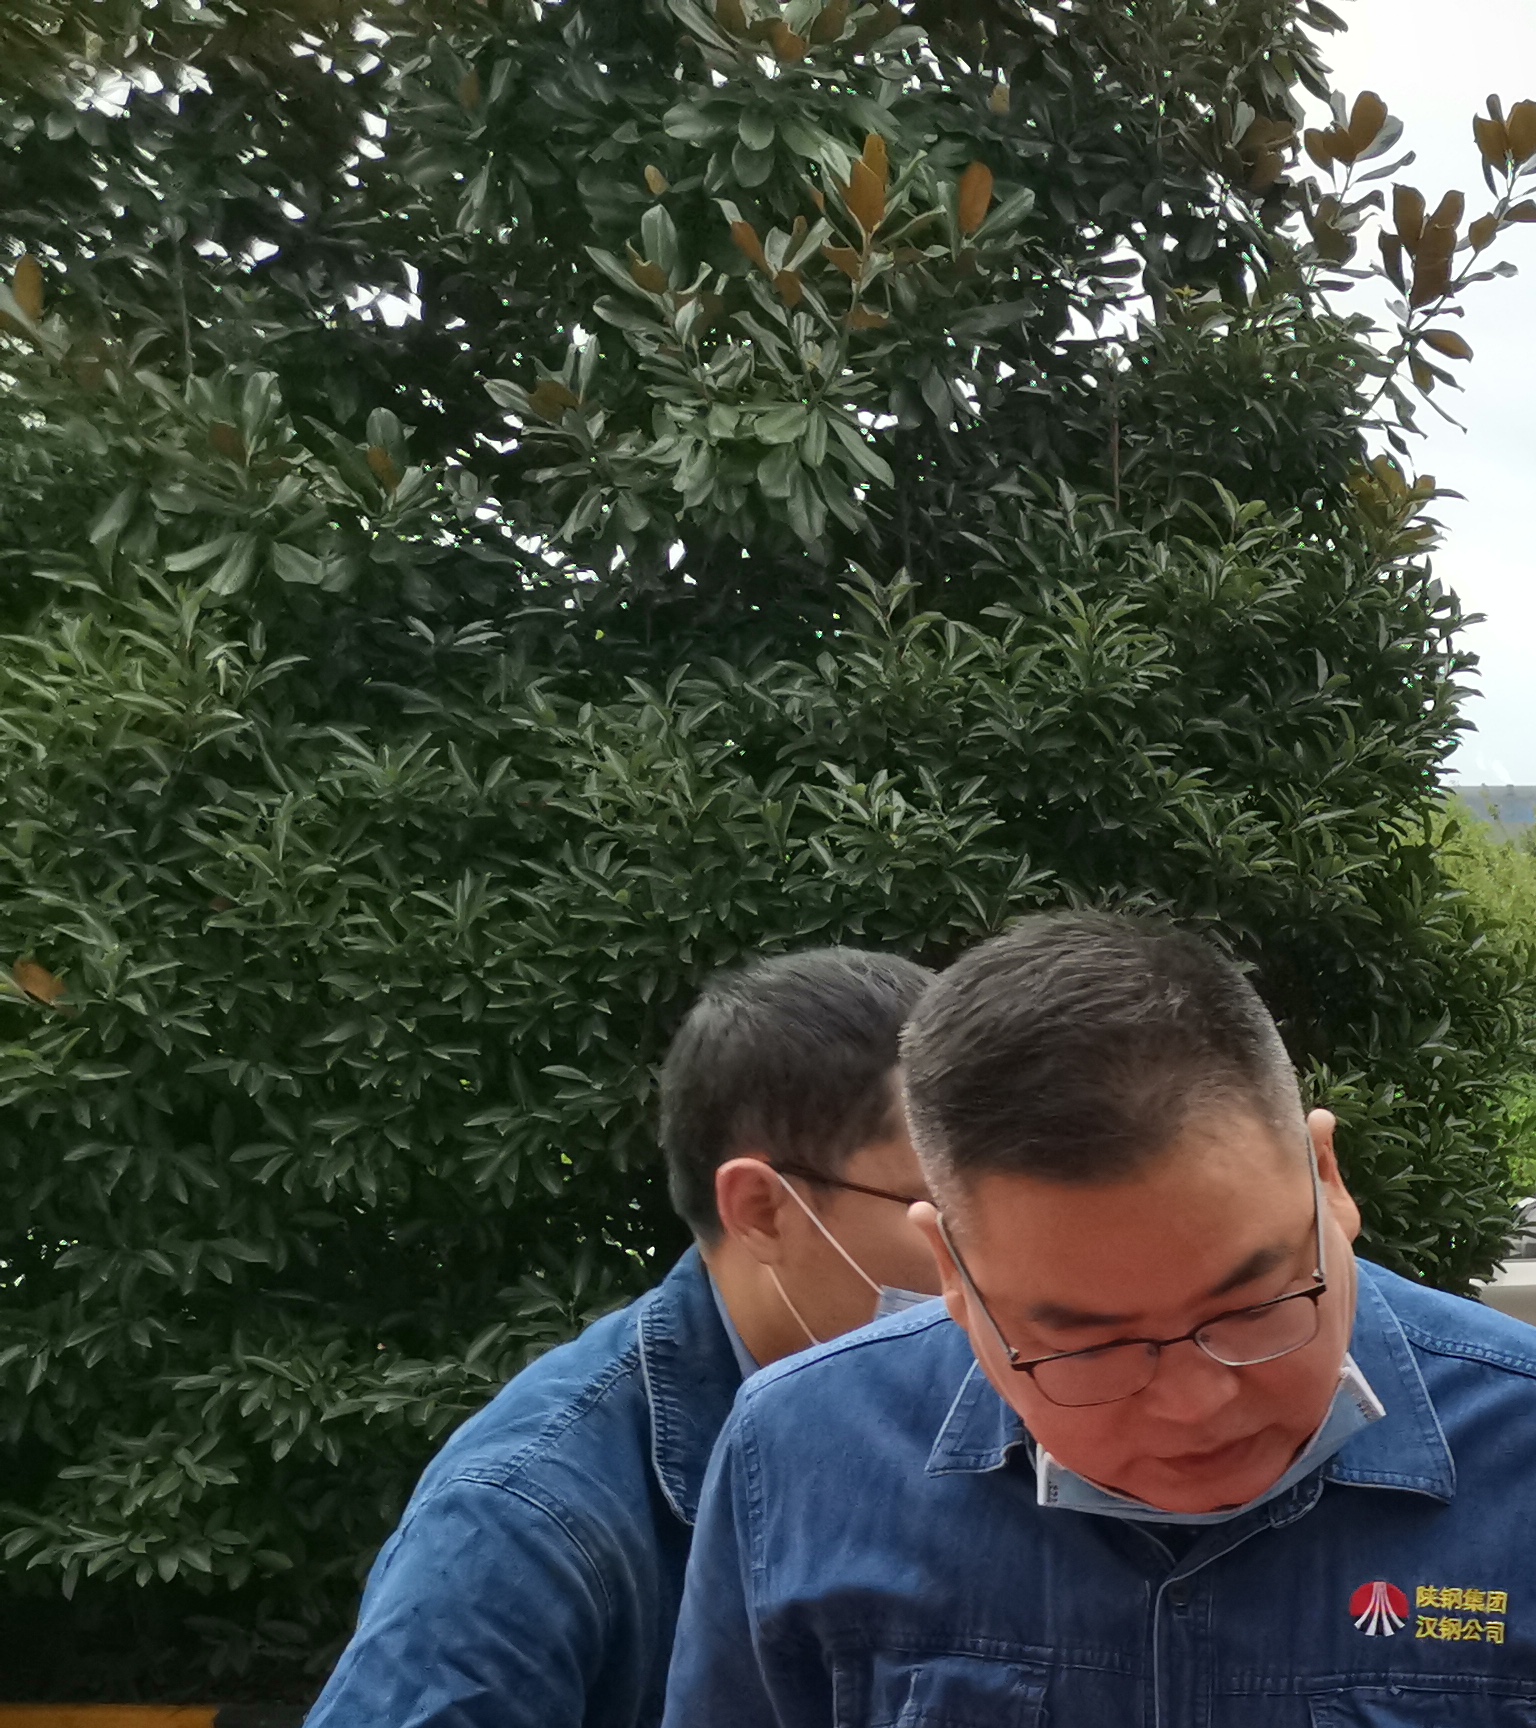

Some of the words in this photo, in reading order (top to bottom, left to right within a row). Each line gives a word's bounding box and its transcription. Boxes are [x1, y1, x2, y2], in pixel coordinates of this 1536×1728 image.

[1415, 1585, 1508, 1614] 陕钢集团
[1415, 1615, 1505, 1645] 汉钢公司
